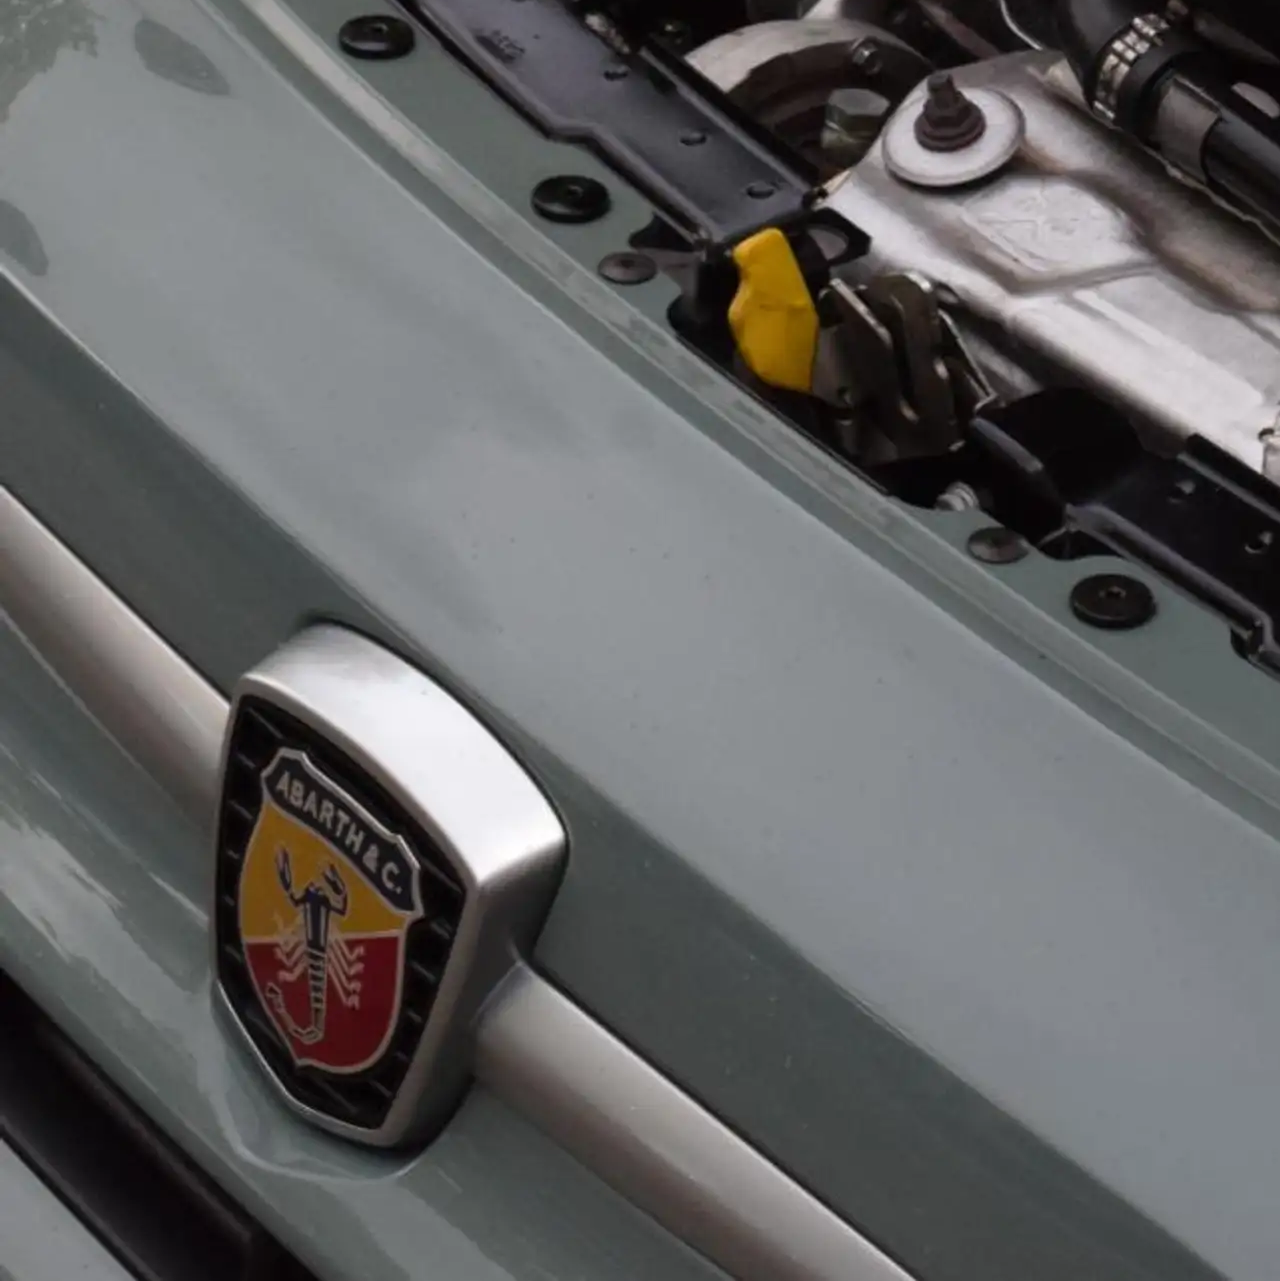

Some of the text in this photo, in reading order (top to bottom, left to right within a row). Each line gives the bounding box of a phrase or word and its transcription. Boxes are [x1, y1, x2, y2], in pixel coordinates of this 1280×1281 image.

[276, 771, 403, 894] ABARTH & C.
